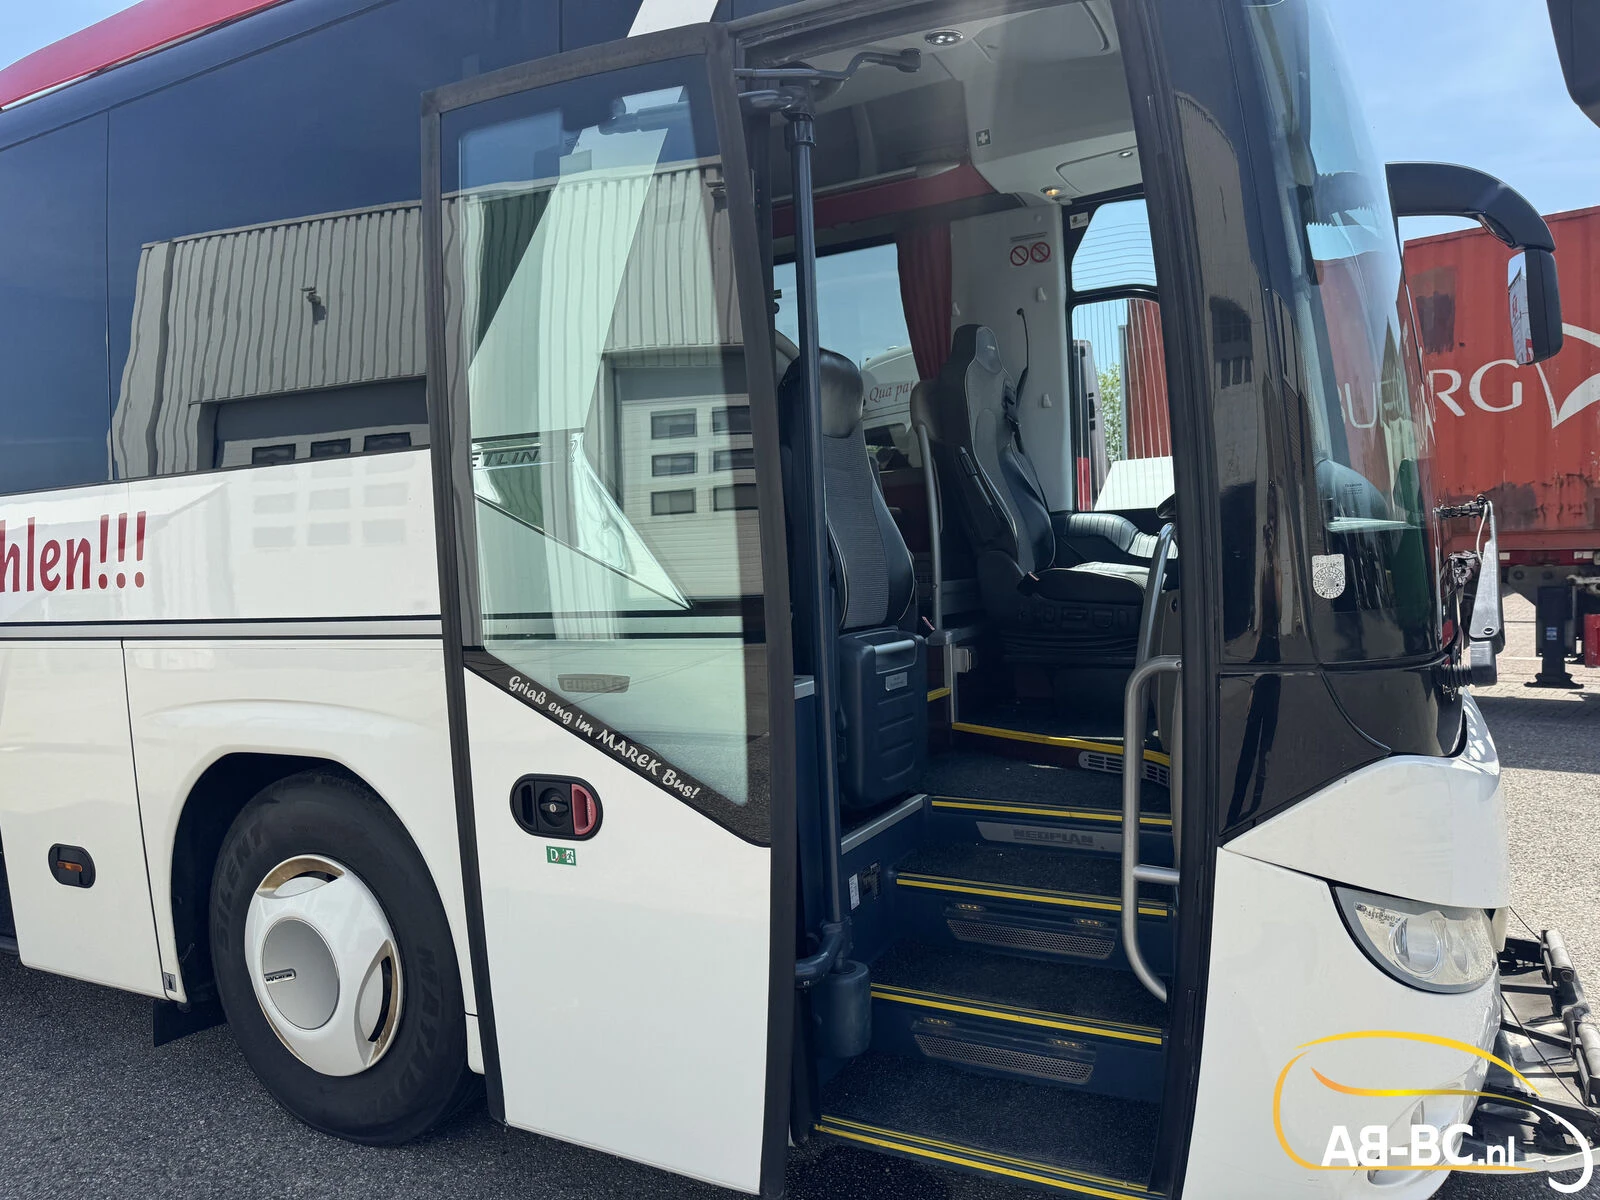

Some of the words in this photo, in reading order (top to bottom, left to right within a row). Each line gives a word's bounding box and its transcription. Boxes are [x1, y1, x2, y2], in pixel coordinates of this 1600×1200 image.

[575, 714, 593, 737] im
[596, 729, 662, 776] MAREK
[662, 768, 702, 800] Bus!
